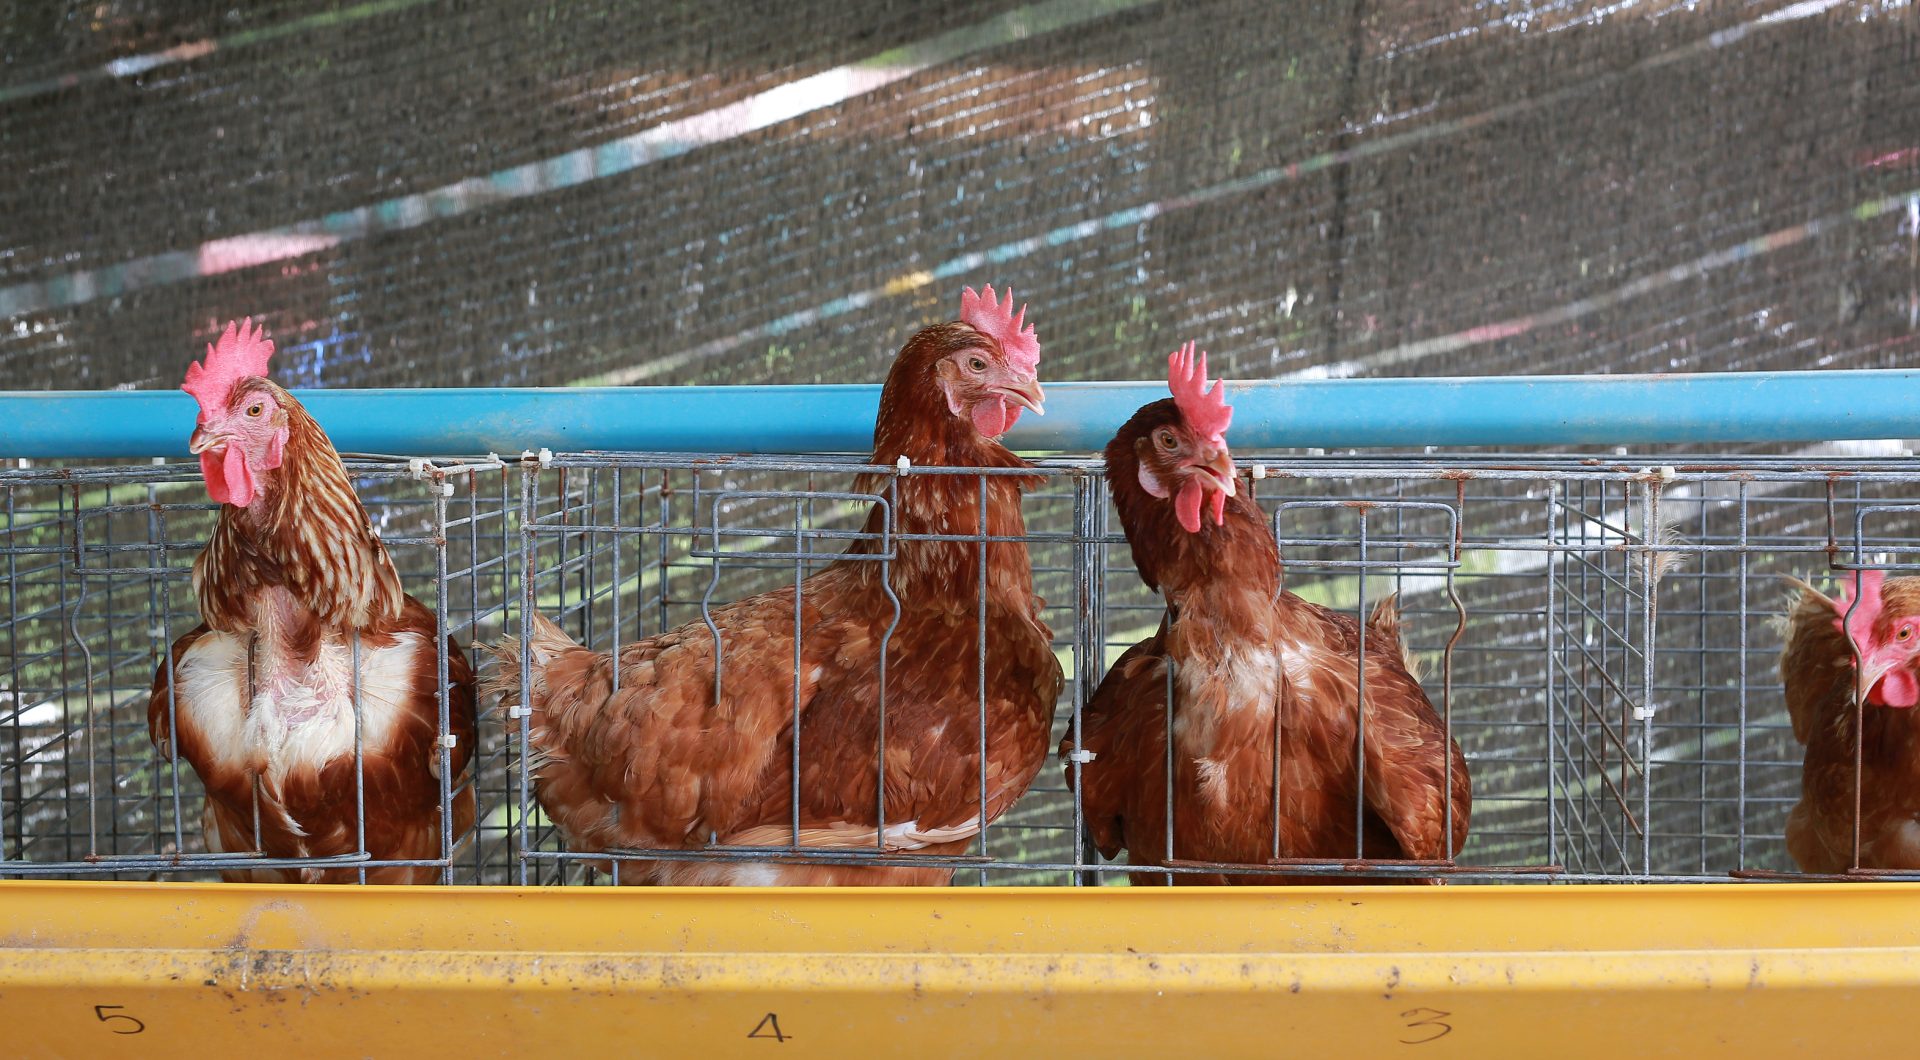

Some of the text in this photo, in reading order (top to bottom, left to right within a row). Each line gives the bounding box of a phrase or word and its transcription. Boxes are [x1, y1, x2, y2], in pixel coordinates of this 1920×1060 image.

[94, 1005, 145, 1035] 5
[747, 1012, 792, 1043] 4
[1399, 1007, 1452, 1044] 3
